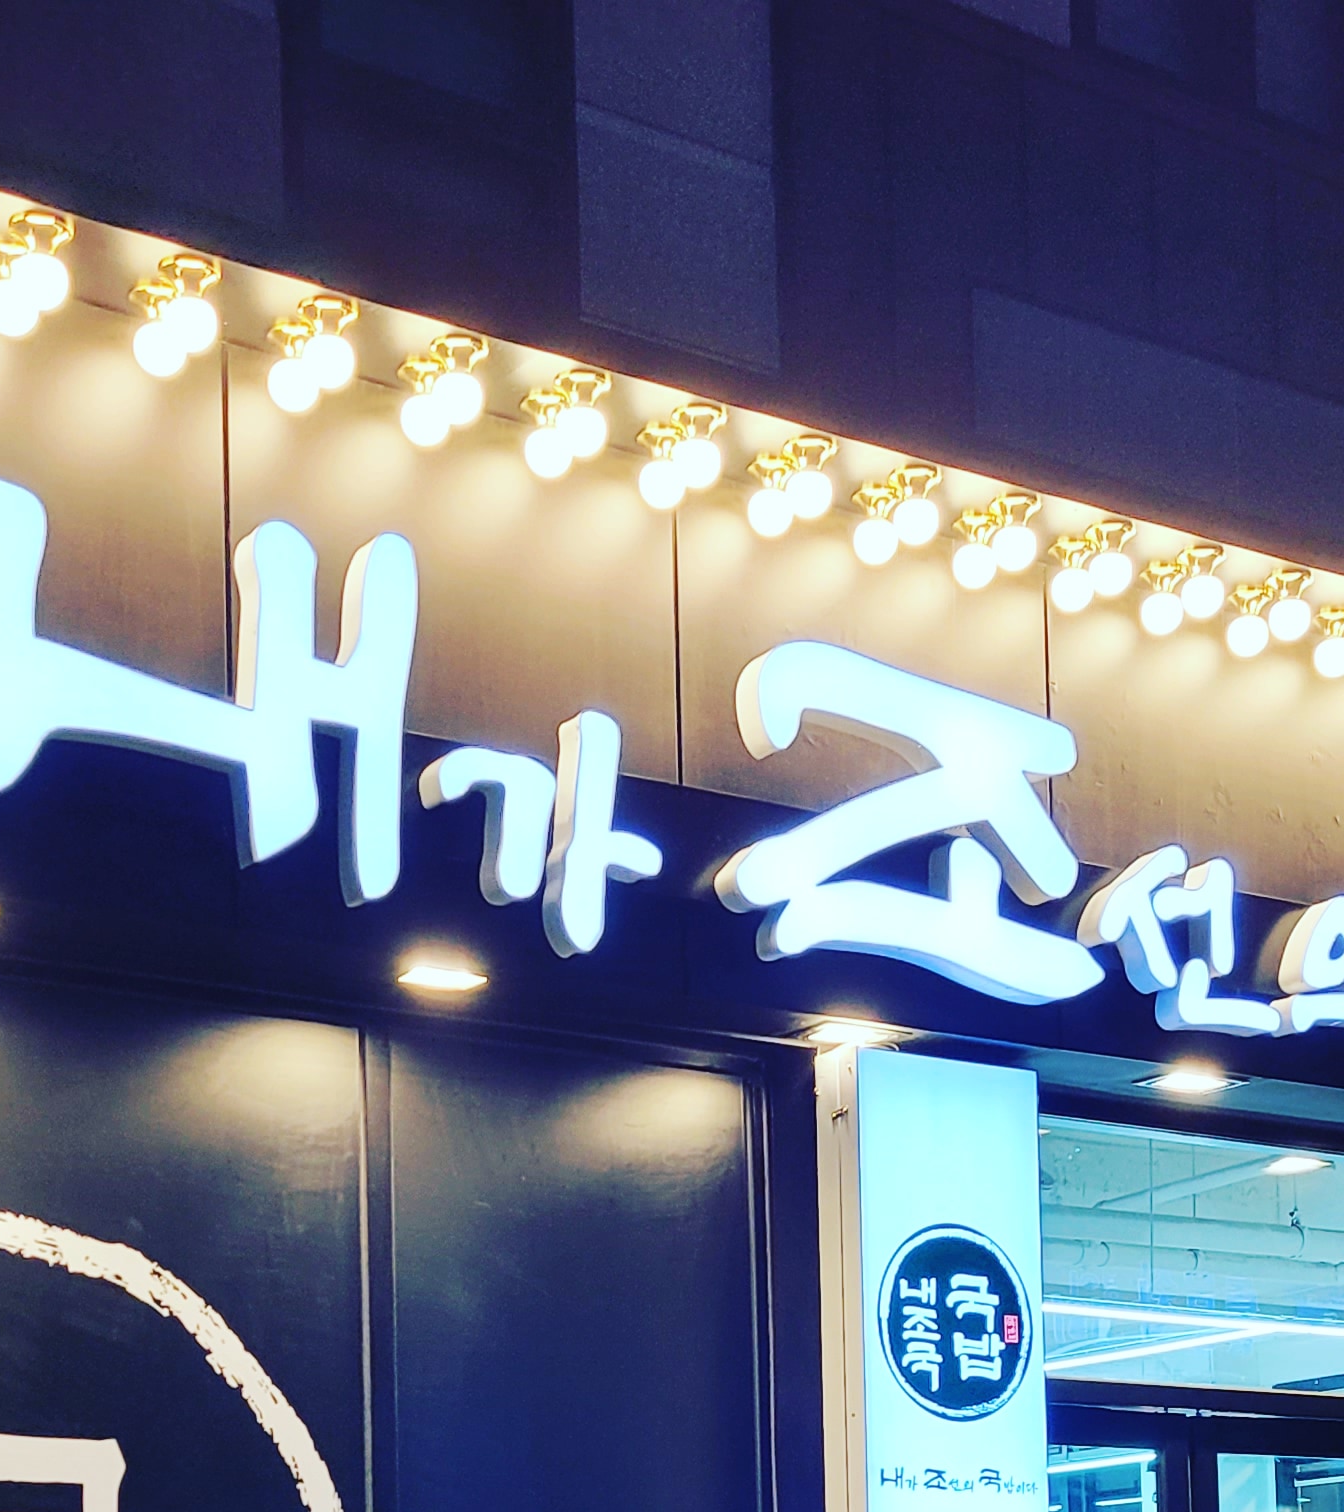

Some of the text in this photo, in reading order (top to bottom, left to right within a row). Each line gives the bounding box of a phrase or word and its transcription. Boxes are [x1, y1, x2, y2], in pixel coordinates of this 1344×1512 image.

[899, 1277, 943, 1392] 내조국
[945, 1273, 1005, 1381] 국밥
[880, 1466, 1039, 1495] 내가 조선의 국밥이다
